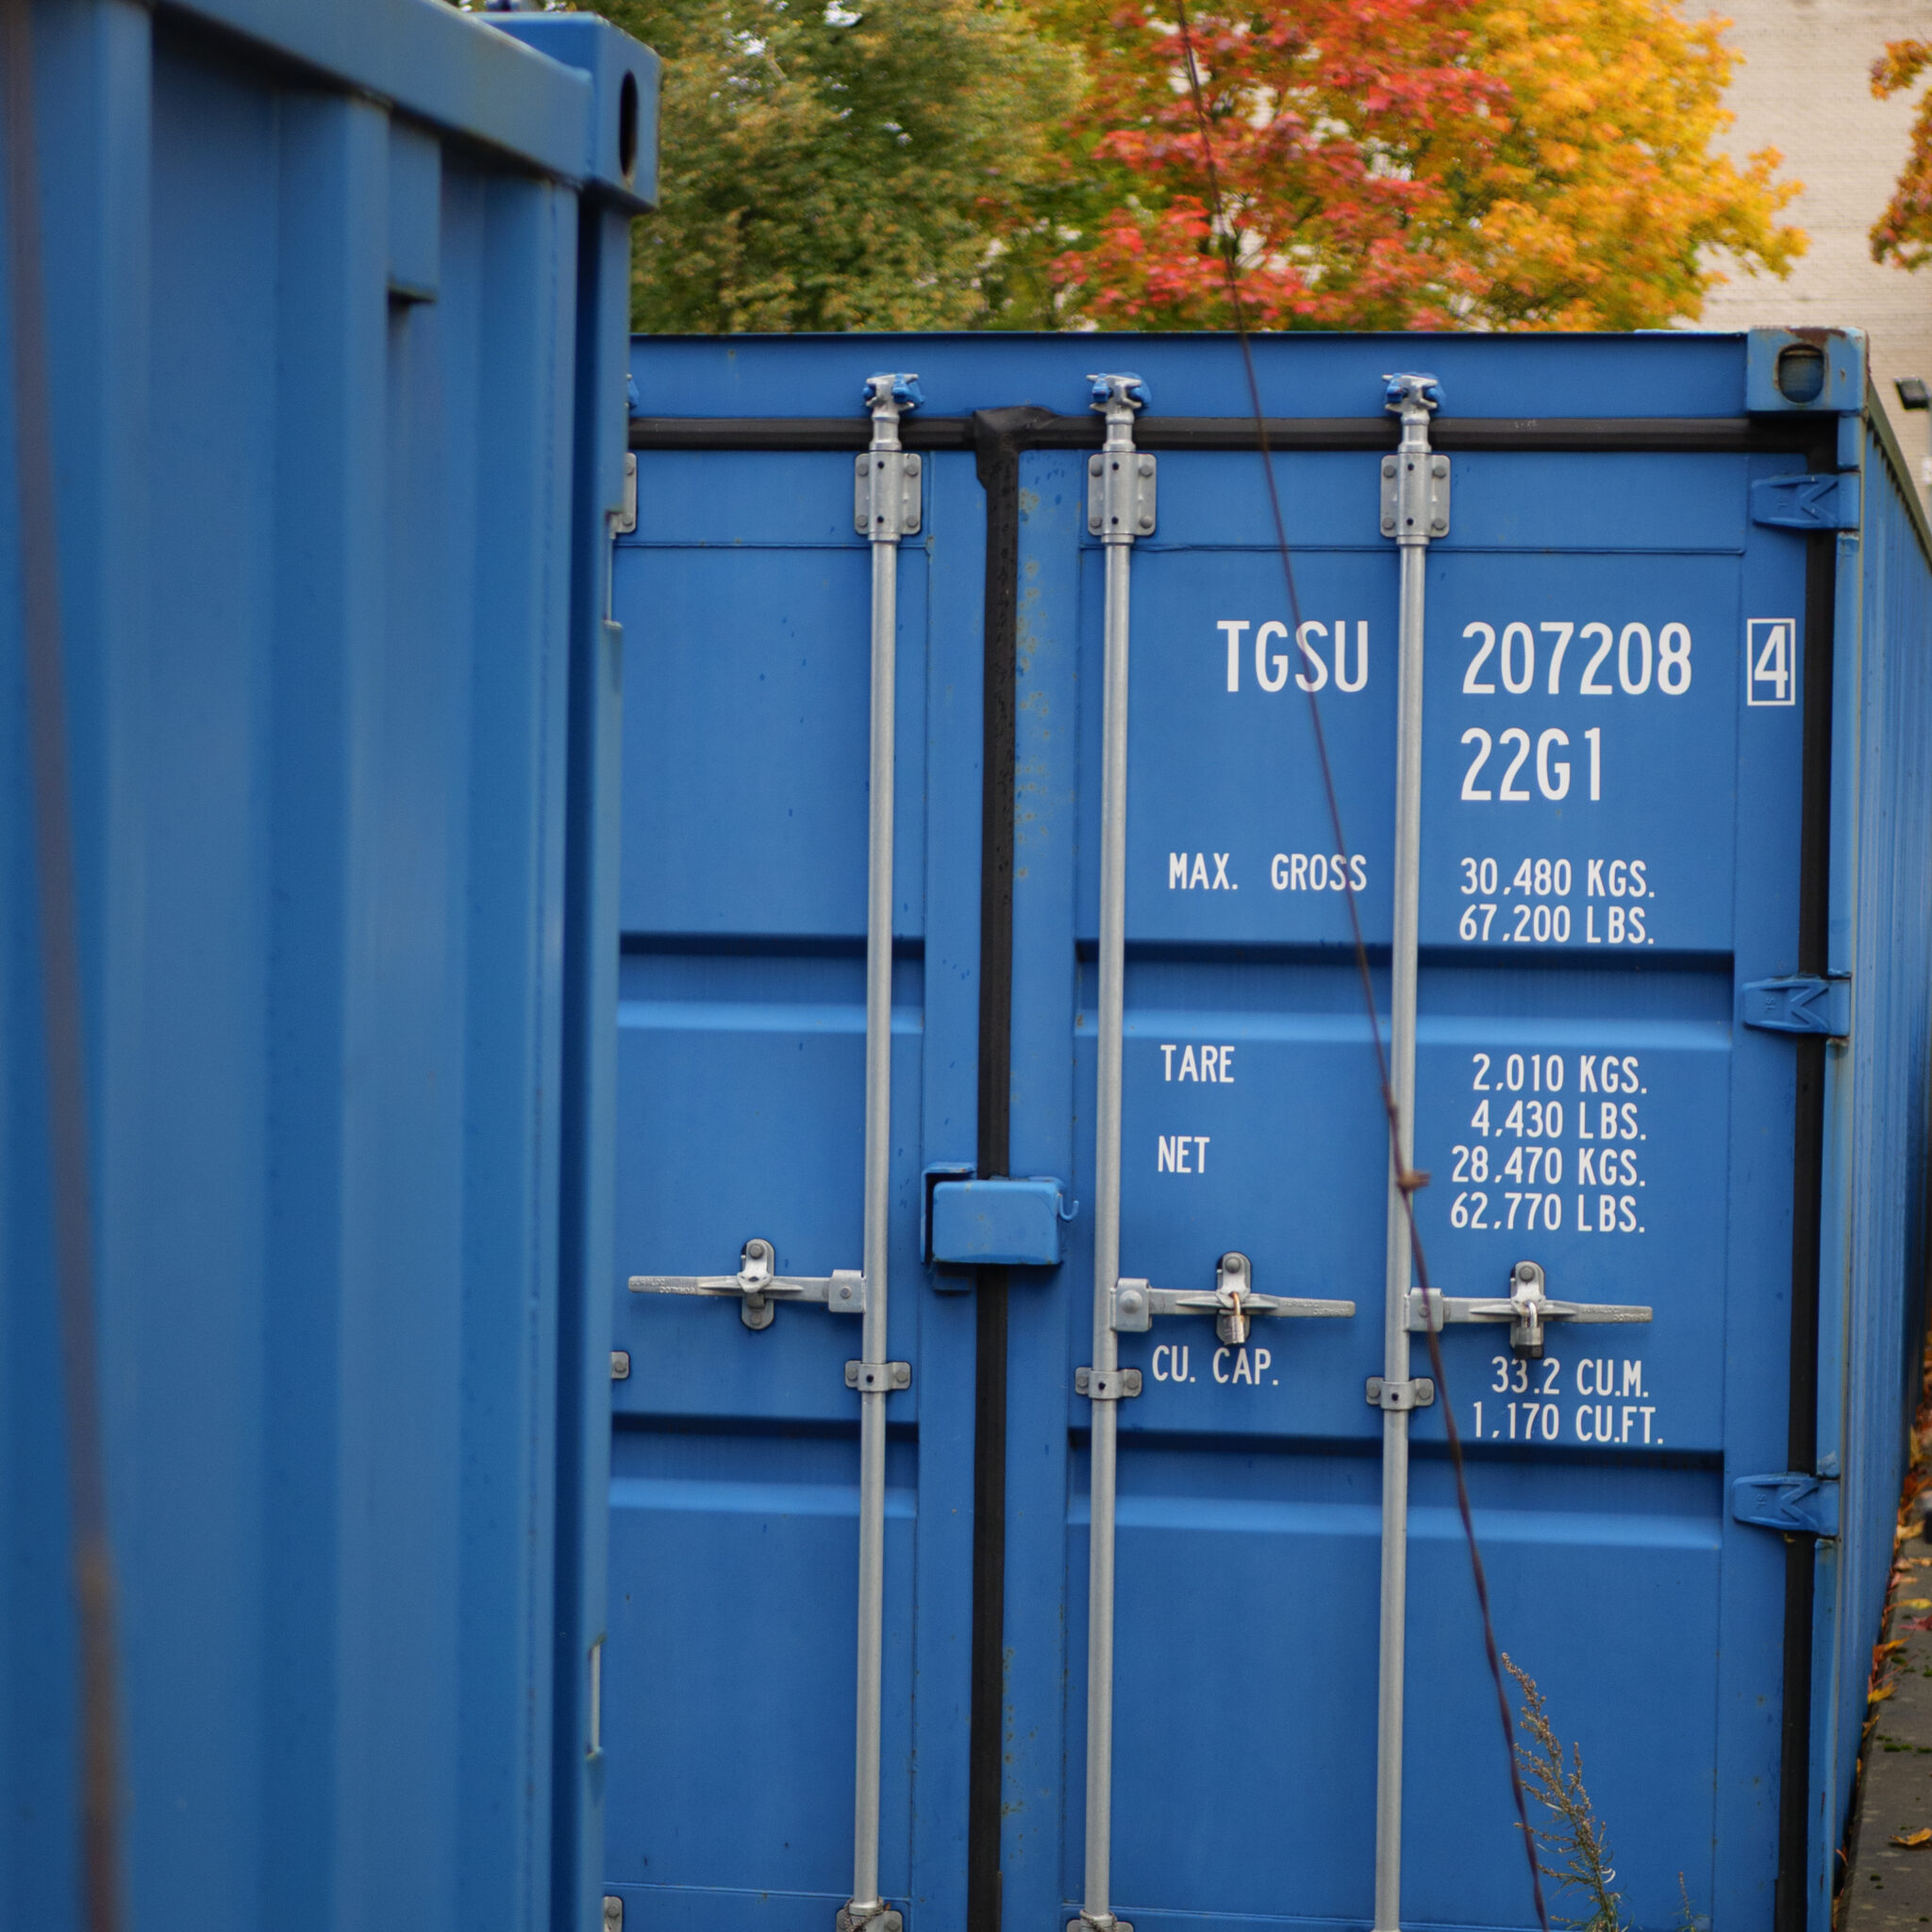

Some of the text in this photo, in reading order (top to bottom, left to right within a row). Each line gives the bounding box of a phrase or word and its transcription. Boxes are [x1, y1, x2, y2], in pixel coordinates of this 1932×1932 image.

[1216, 619, 1790, 700] TGSU 207208 4
[1460, 726, 1601, 803] 22G1
[1169, 852, 1656, 898] MAX. GROSS 30,480 KGS.
[1458, 903, 1655, 945] 67,200 LBS.
[1159, 1044, 1647, 1094] TARE 2,010 KGS.
[1470, 1098, 1647, 1141] 4,430 LBS.
[1158, 1135, 1646, 1187] NET 28,470 KGS.
[1450, 1191, 1646, 1233] 62,770 LBS.
[1152, 1344, 1650, 1398] CU. CAP. 33.2 CU.M.
[1473, 1401, 1665, 1445] 1,170 CU.FT.
